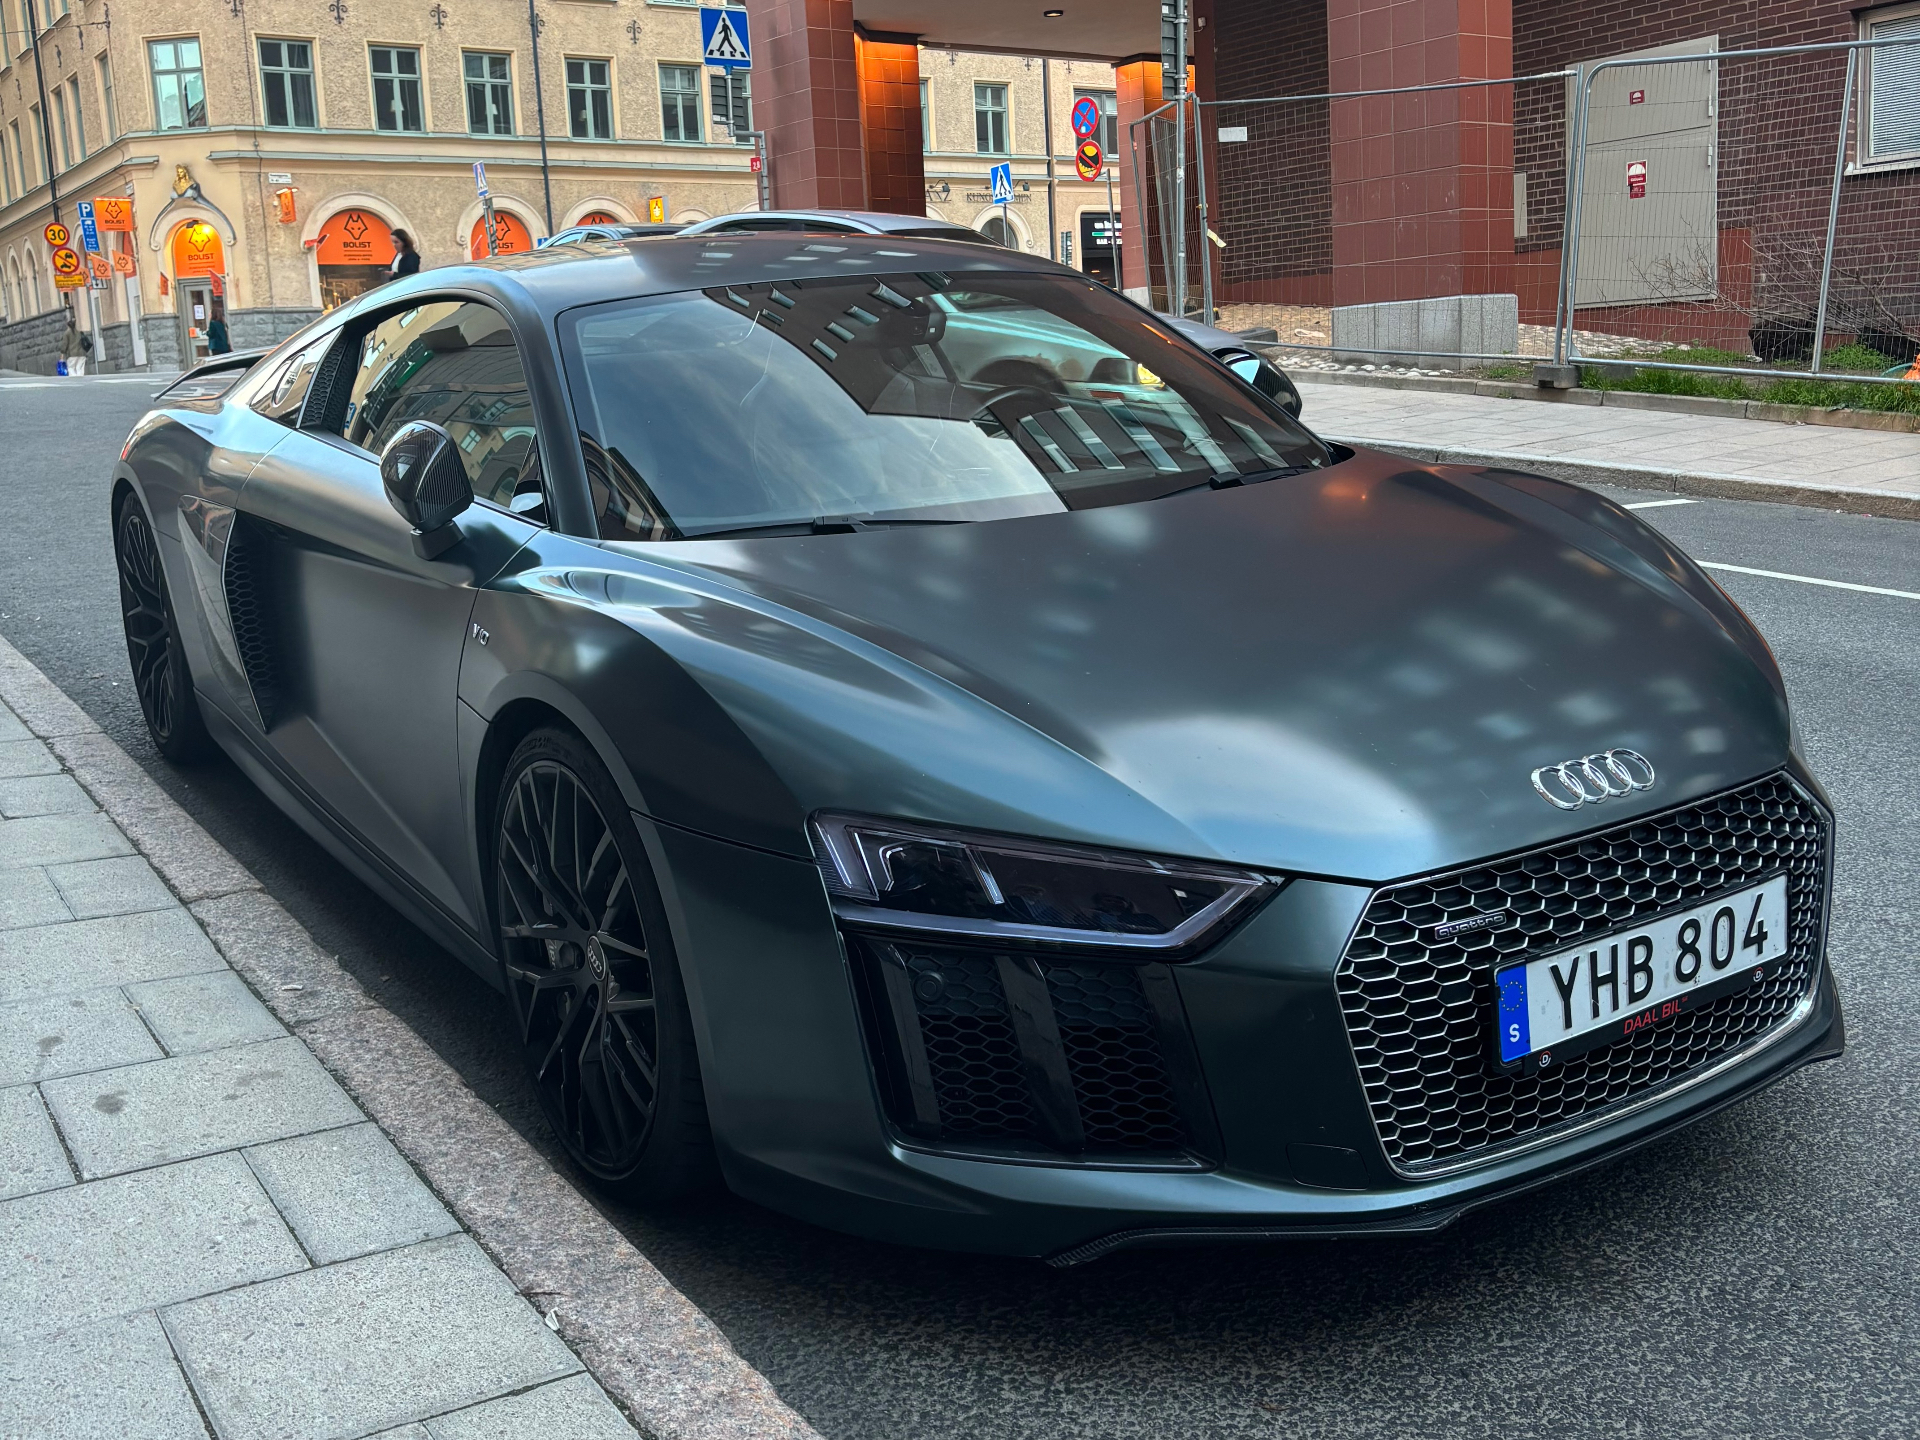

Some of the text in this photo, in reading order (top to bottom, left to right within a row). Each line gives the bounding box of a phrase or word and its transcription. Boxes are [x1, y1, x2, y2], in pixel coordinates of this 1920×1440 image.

[82, 204, 90, 216] P
[48, 228, 66, 242] 30
[188, 252, 215, 260] BOLIST
[1439, 916, 1504, 936] quattro
[1549, 892, 1768, 1030] YHB 804
[1624, 1008, 1658, 1034] DAAL
[1662, 1000, 1682, 1018] BIL
[1510, 1024, 1520, 1042] S
